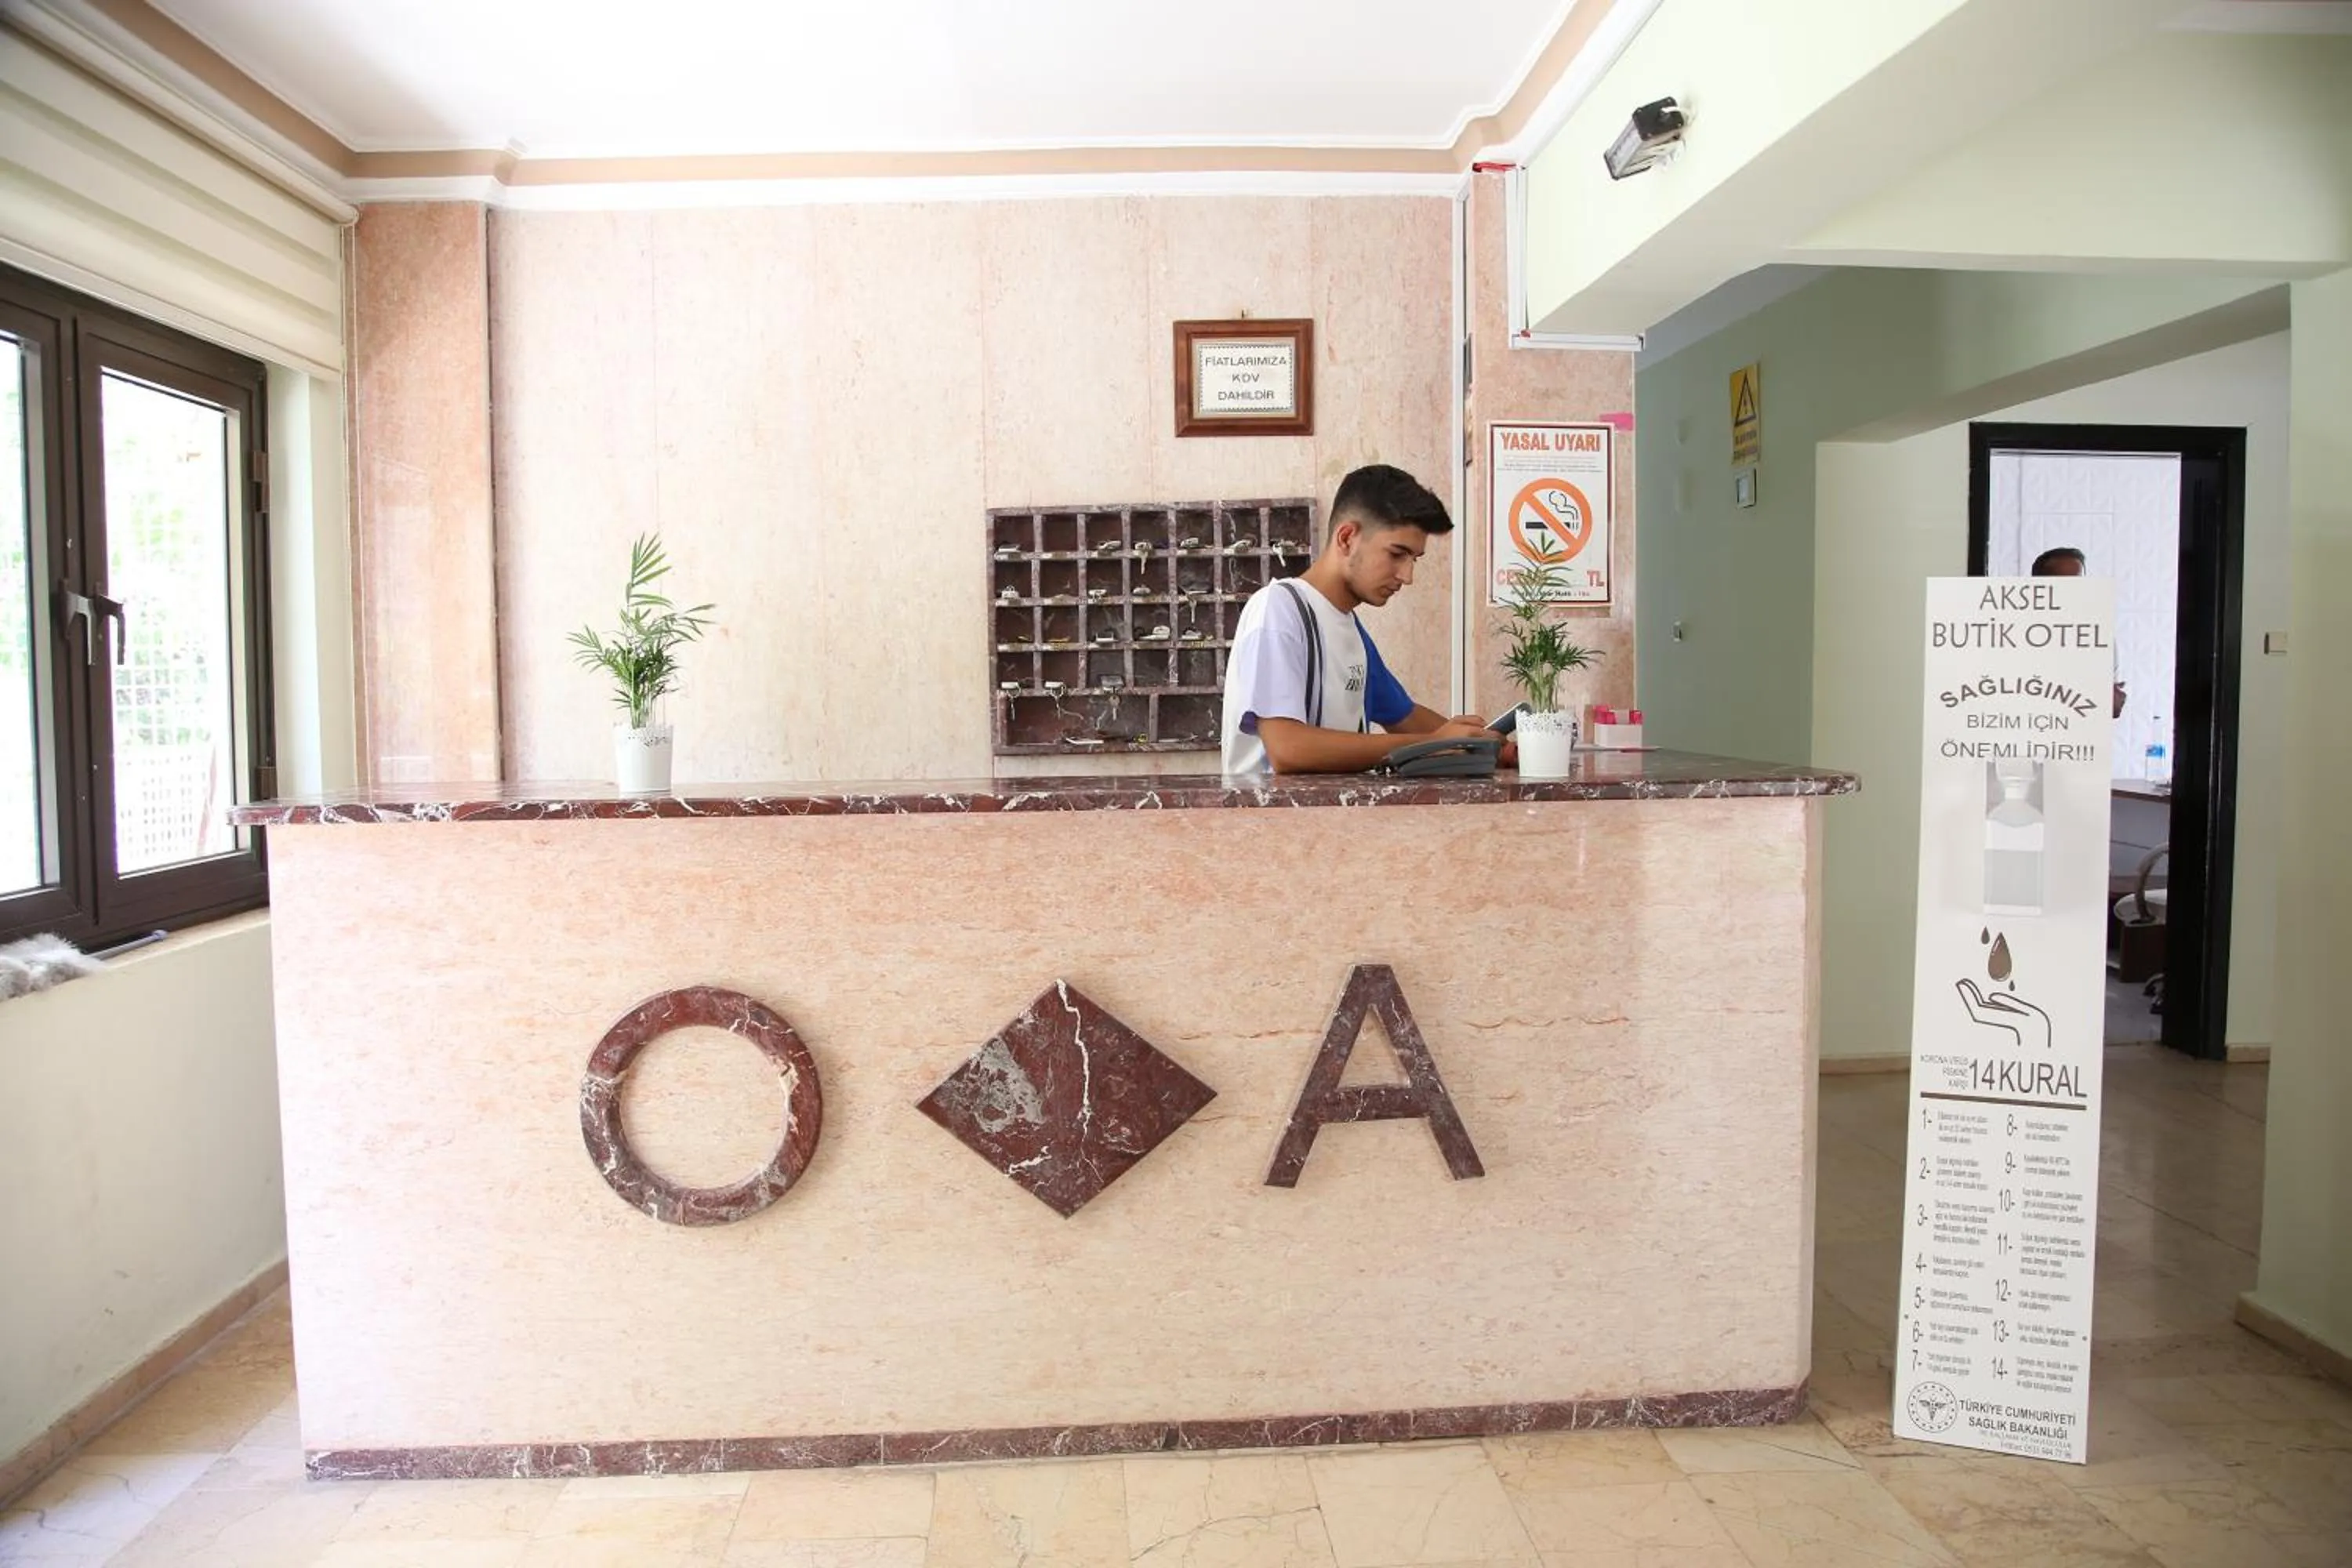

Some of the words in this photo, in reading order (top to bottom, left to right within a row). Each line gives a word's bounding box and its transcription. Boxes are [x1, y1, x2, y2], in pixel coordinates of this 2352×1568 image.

[1232, 372, 1260, 383] KDV
[1501, 432, 1550, 451] YASAL
[1555, 433, 1601, 452] UYARI
[1979, 584, 2062, 611] AKSEL
[1932, 618, 2017, 649] BUTİK
[2025, 622, 2109, 649] OTEL
[1939, 673, 2098, 719] SAĞLIĞINIZ
[1966, 712, 2021, 730] BİZİM
[2027, 712, 2070, 733] İÇİN
[579, 985, 823, 1227] O
[1262, 962, 1486, 1189] A
